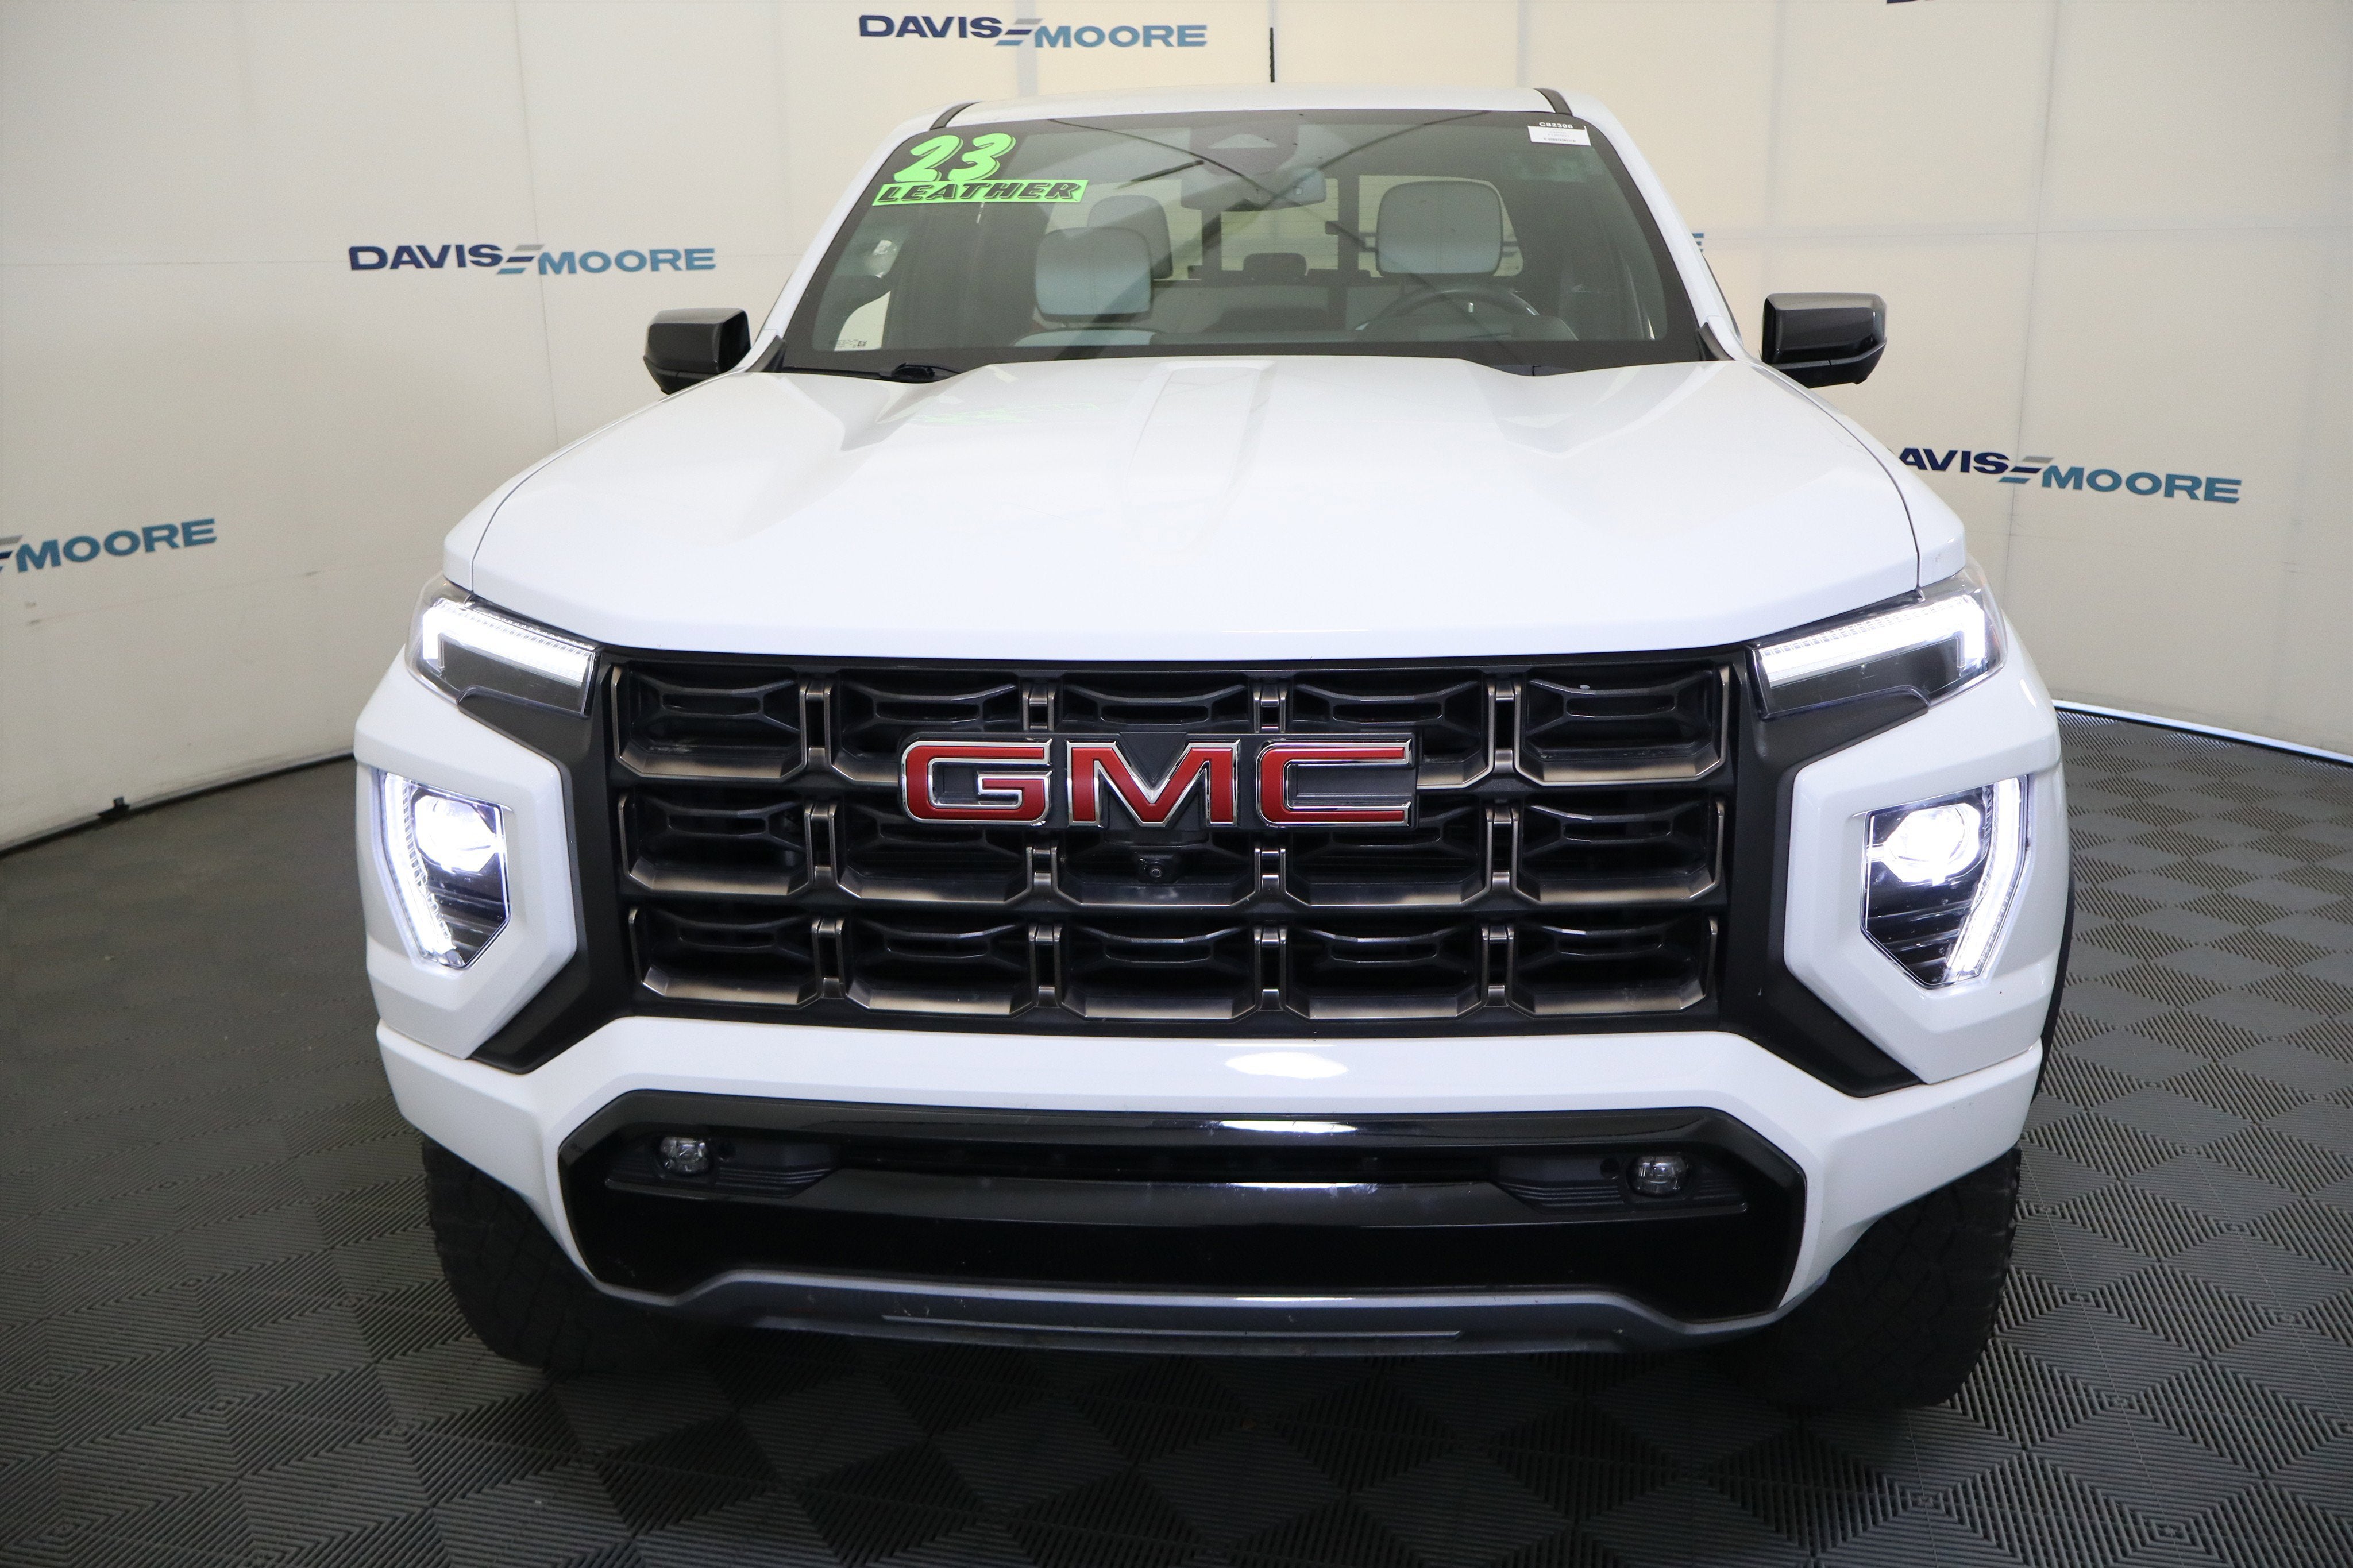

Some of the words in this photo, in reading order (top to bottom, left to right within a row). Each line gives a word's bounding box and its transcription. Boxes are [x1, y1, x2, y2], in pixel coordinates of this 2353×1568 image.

[859, 14, 1002, 38] DAVIS
[1033, 25, 1208, 48] MOORE
[893, 133, 1016, 183] 23
[878, 182, 1082, 203] LEATHER
[348, 244, 503, 271] DAVIS
[538, 248, 716, 275] MOORE
[1899, 447, 2010, 474] AVIS
[2042, 465, 2242, 504] MOORE
[15, 518, 217, 573] MOORE
[900, 737, 1411, 827] GMC
